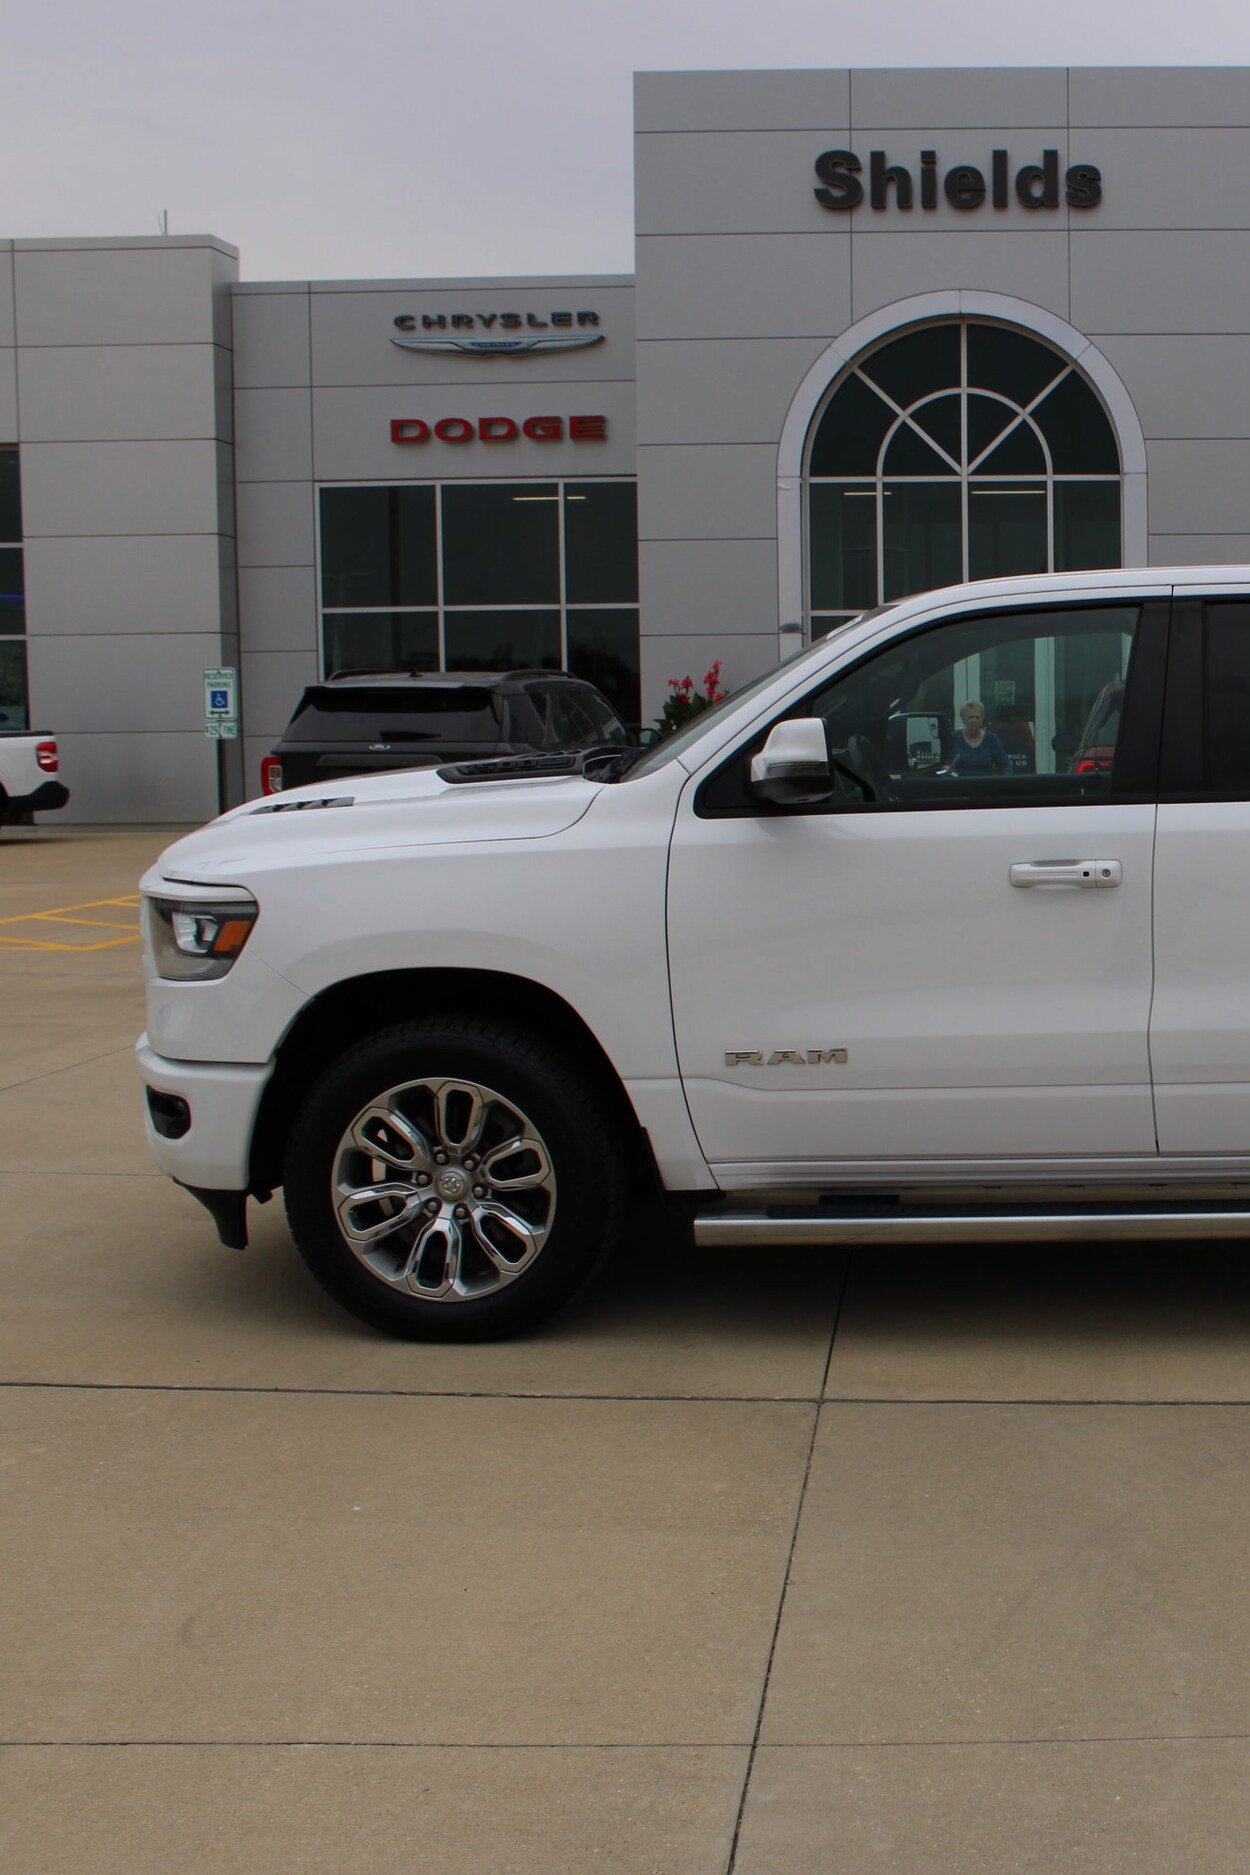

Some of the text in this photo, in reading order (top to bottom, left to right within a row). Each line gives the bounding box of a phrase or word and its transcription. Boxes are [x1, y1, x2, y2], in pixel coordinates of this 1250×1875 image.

[813, 149, 1102, 209] Shields
[393, 311, 600, 331] CHRYSLER
[390, 415, 607, 443] DODGE
[725, 1048, 848, 1066] RAM
